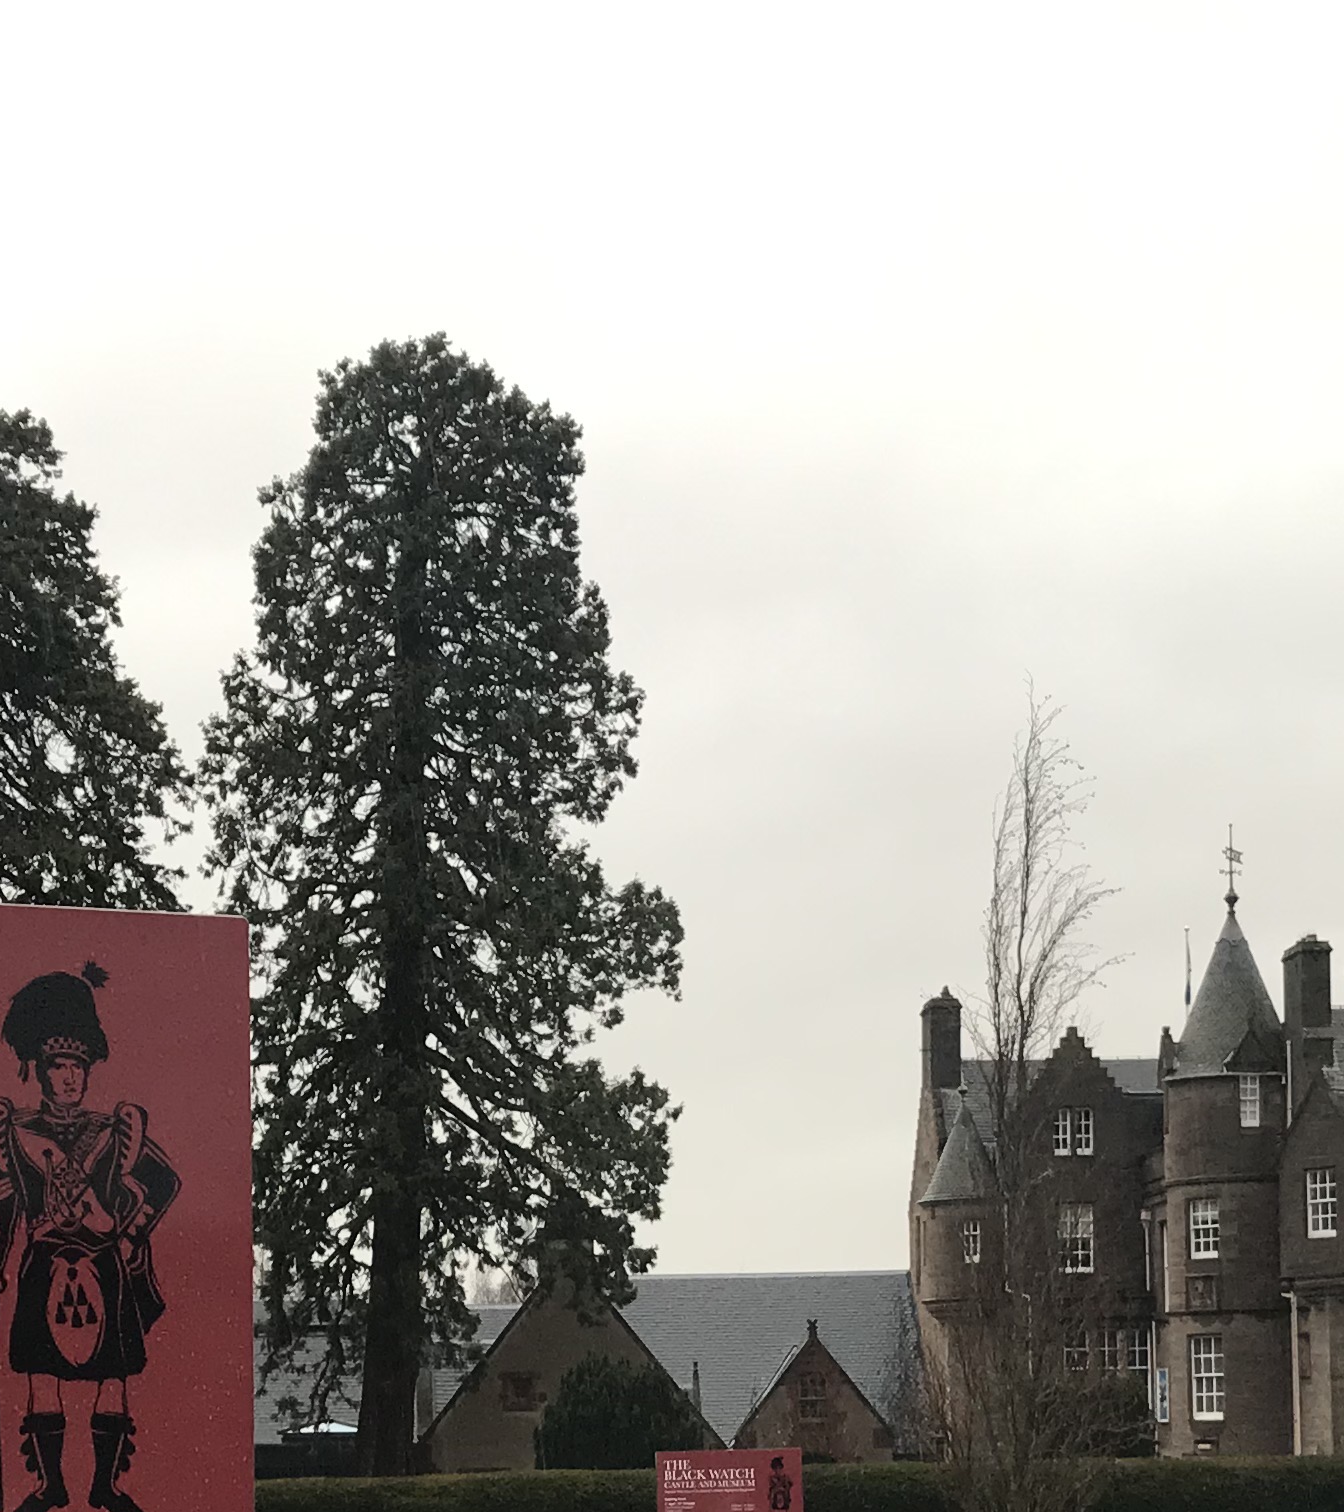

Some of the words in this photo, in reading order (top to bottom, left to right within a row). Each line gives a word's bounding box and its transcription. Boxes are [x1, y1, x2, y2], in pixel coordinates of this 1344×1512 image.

[663, 1460, 691, 1470] THE
[664, 1469, 706, 1480] BLACK
[708, 1468, 755, 1479] WATCH
